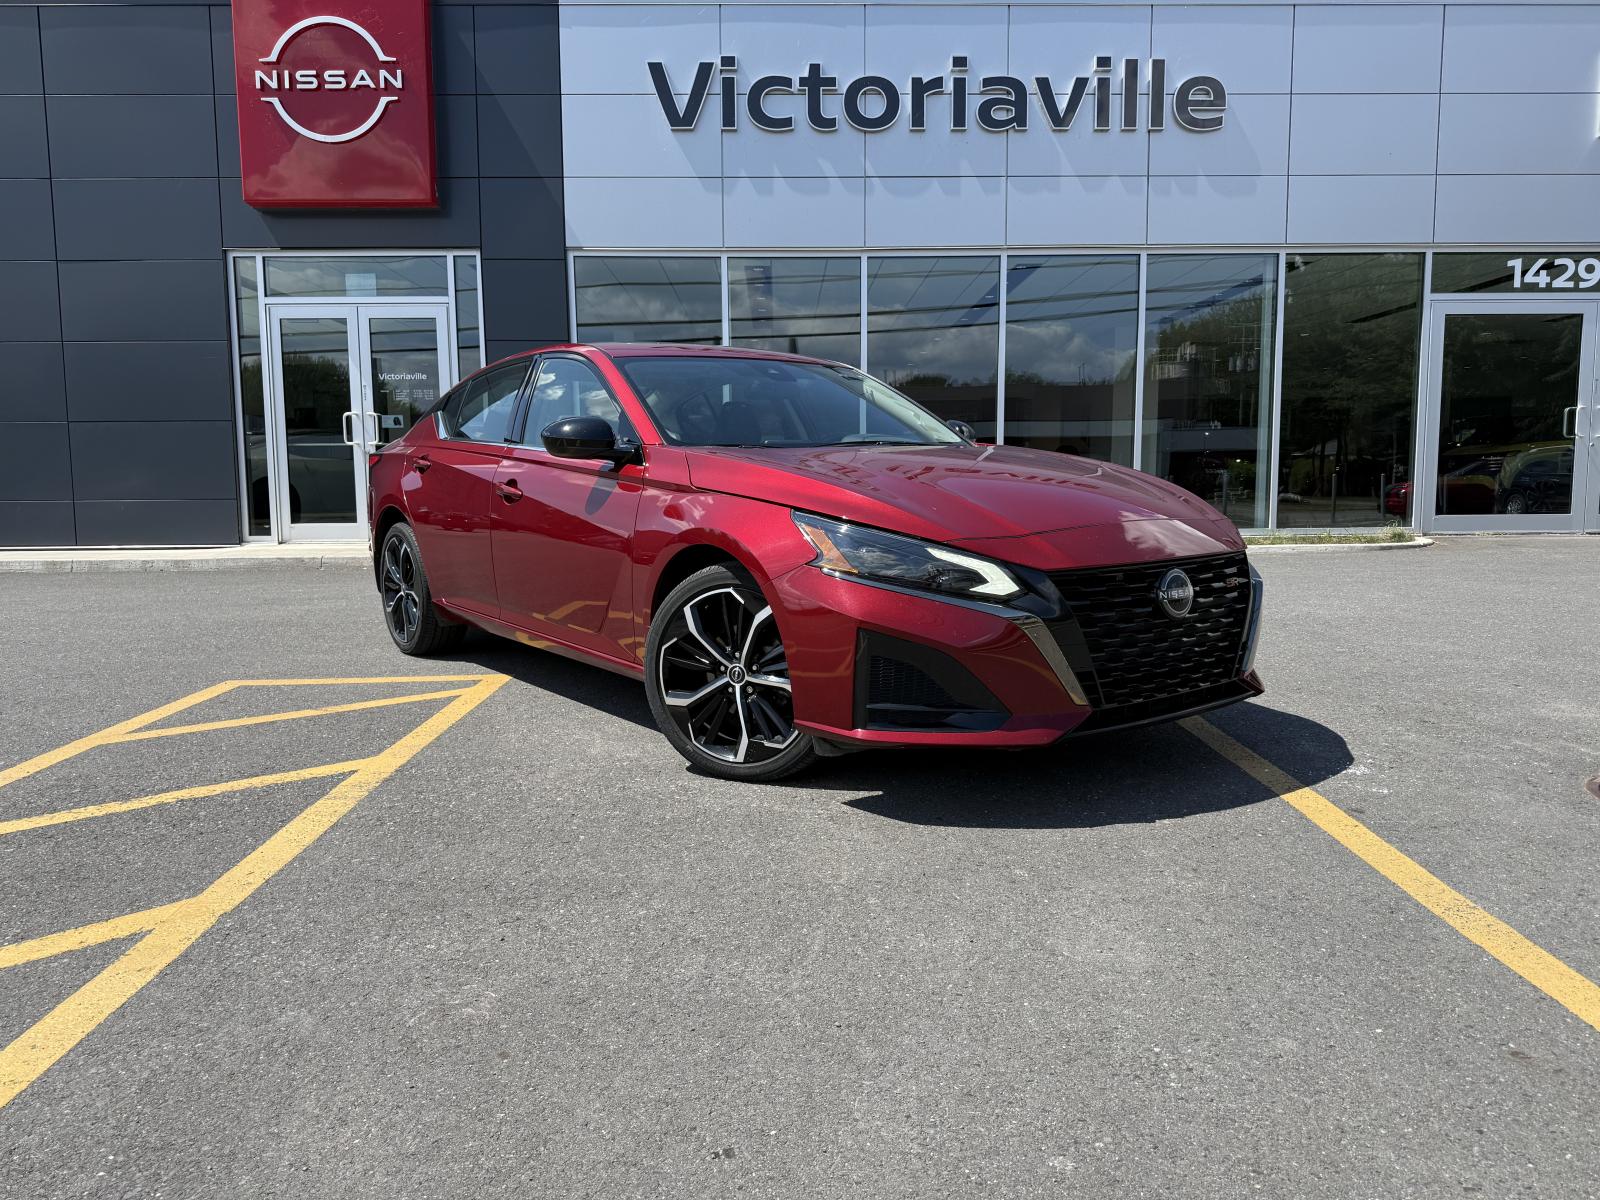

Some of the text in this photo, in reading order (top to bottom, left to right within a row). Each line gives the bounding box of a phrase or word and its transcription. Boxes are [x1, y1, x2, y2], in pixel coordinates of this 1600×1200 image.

[254, 69, 403, 90] NISSAN
[647, 55, 1228, 132] Victoriaville
[1506, 257, 1600, 289] 1429
[378, 372, 428, 380] Victoriaville
